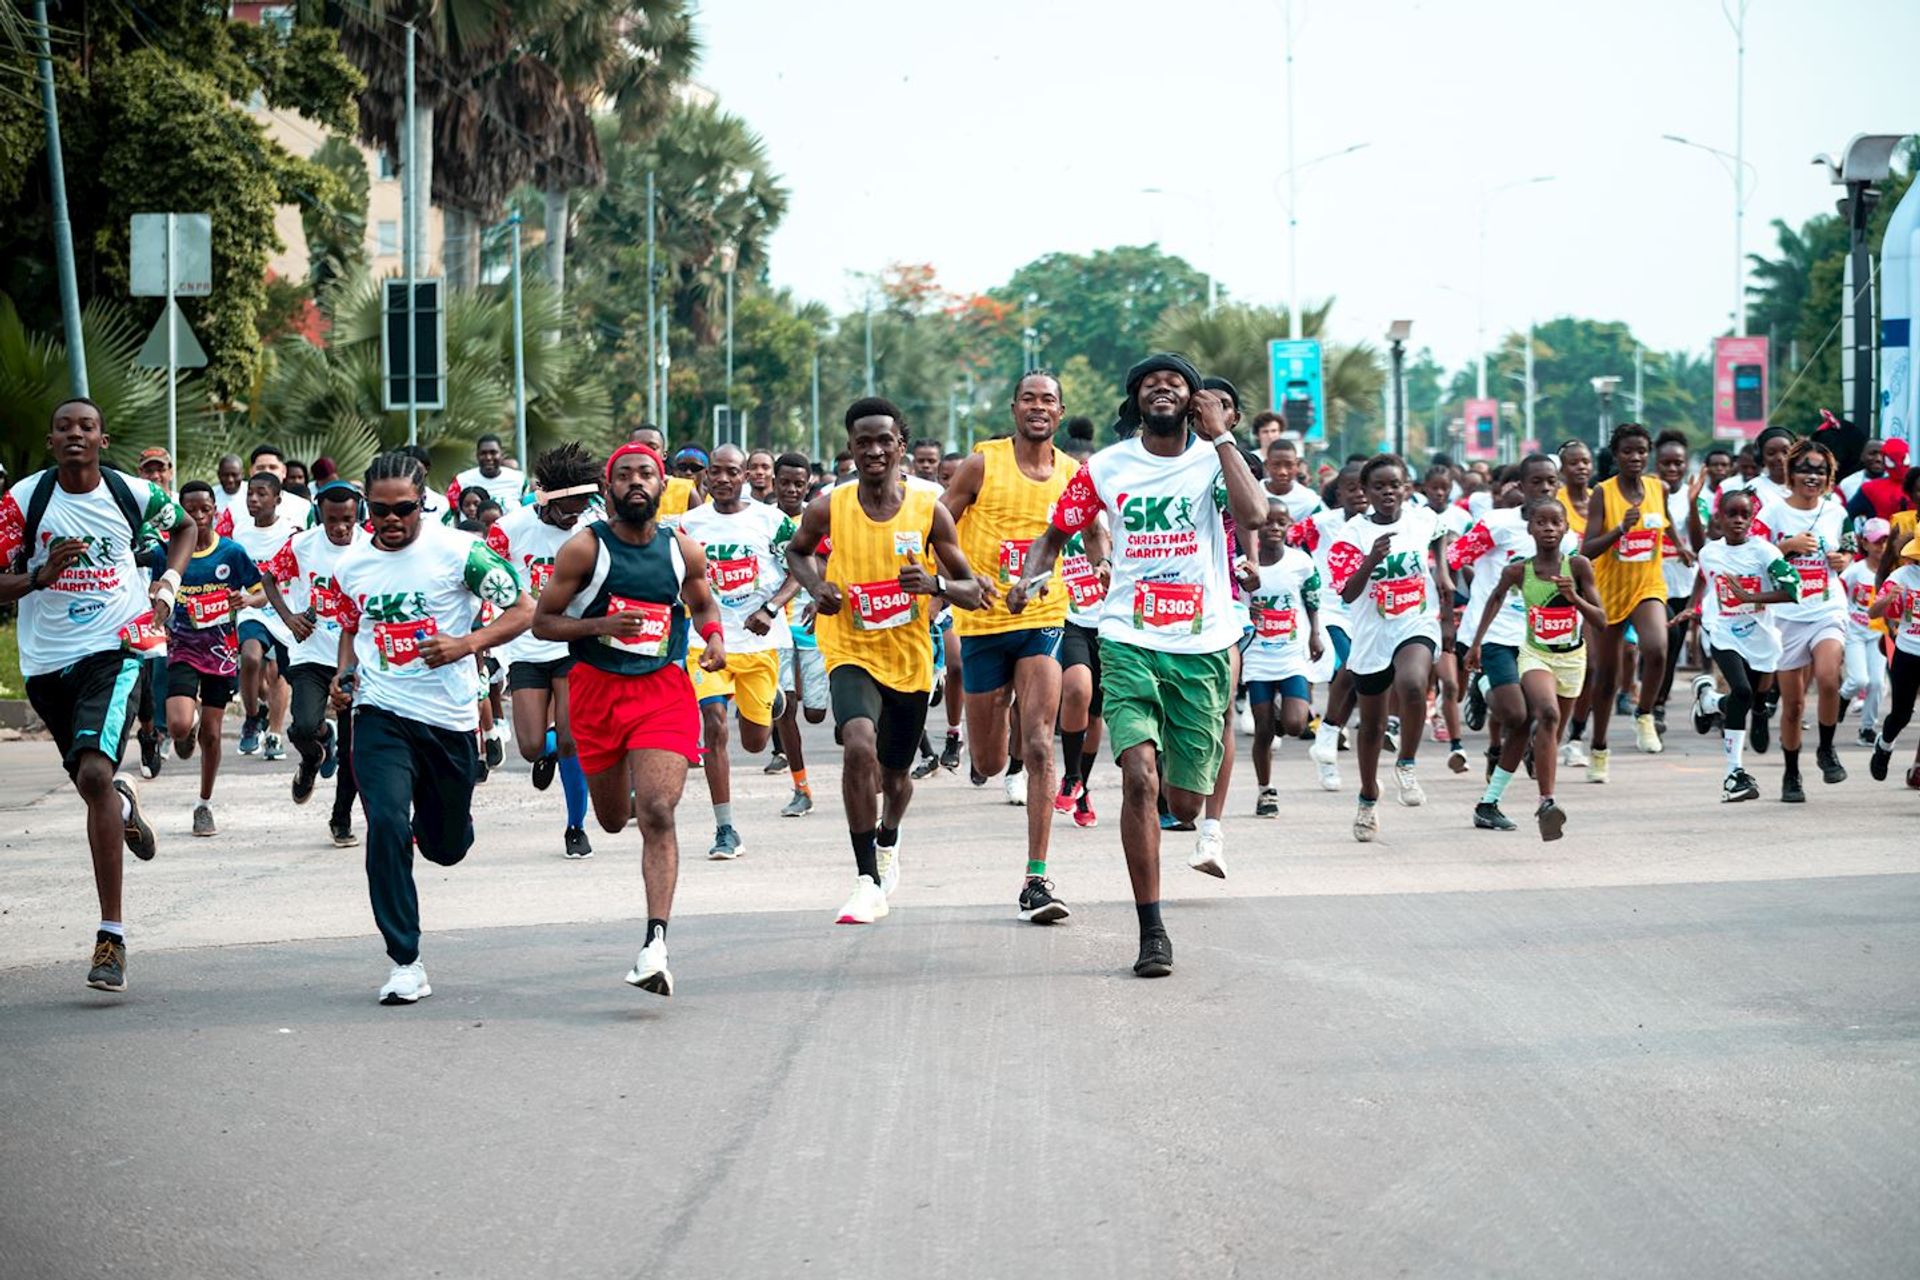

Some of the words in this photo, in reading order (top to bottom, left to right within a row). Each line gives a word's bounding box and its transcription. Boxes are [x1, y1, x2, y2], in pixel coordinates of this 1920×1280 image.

[1128, 532, 1195, 545] CHRISTMAS
[1125, 547, 1172, 559] CHARITY
[1174, 544, 1198, 557] RUN
[724, 566, 754, 583] 5375
[98, 578, 120, 591] RUN
[1082, 583, 1104, 598] 511
[204, 600, 229, 614] 5273
[872, 591, 911, 611] 5340
[1157, 598, 1196, 616] 5303
[640, 618, 665, 636] 302
[1544, 618, 1574, 631] 5373
